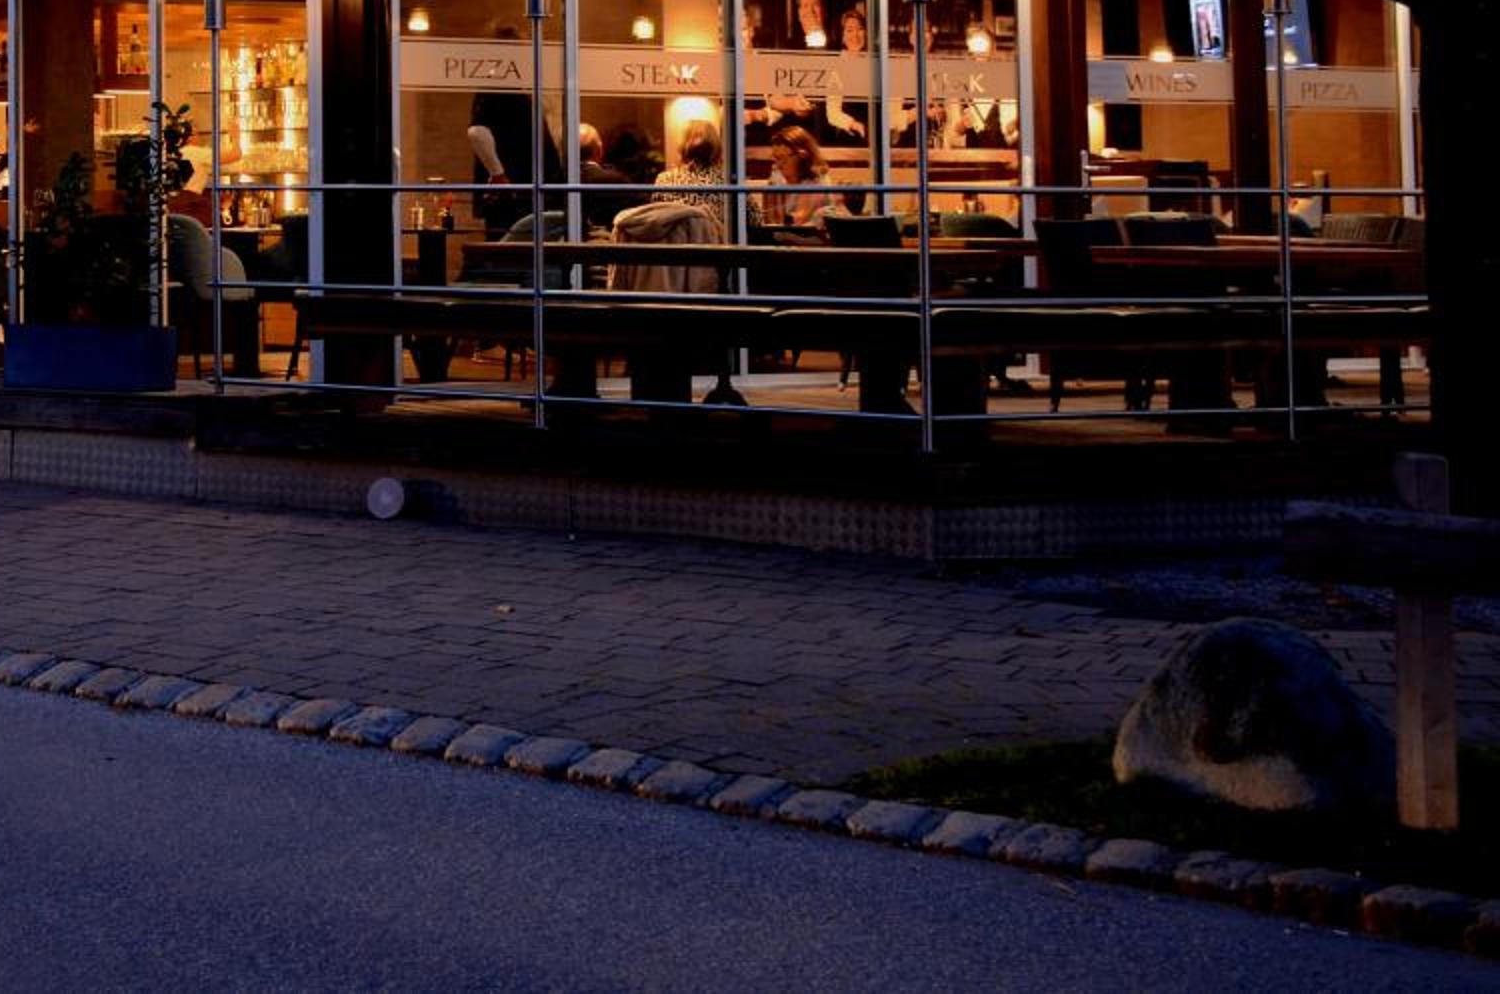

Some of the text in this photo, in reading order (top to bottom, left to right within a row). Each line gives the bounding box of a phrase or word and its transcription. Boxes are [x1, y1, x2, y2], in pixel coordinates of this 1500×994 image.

[443, 58, 522, 80] PIZZA
[620, 63, 700, 86] STEAK
[774, 69, 843, 91] PIZZA
[1126, 72, 1198, 93] WINES
[1301, 80, 1360, 101] PIZZA
